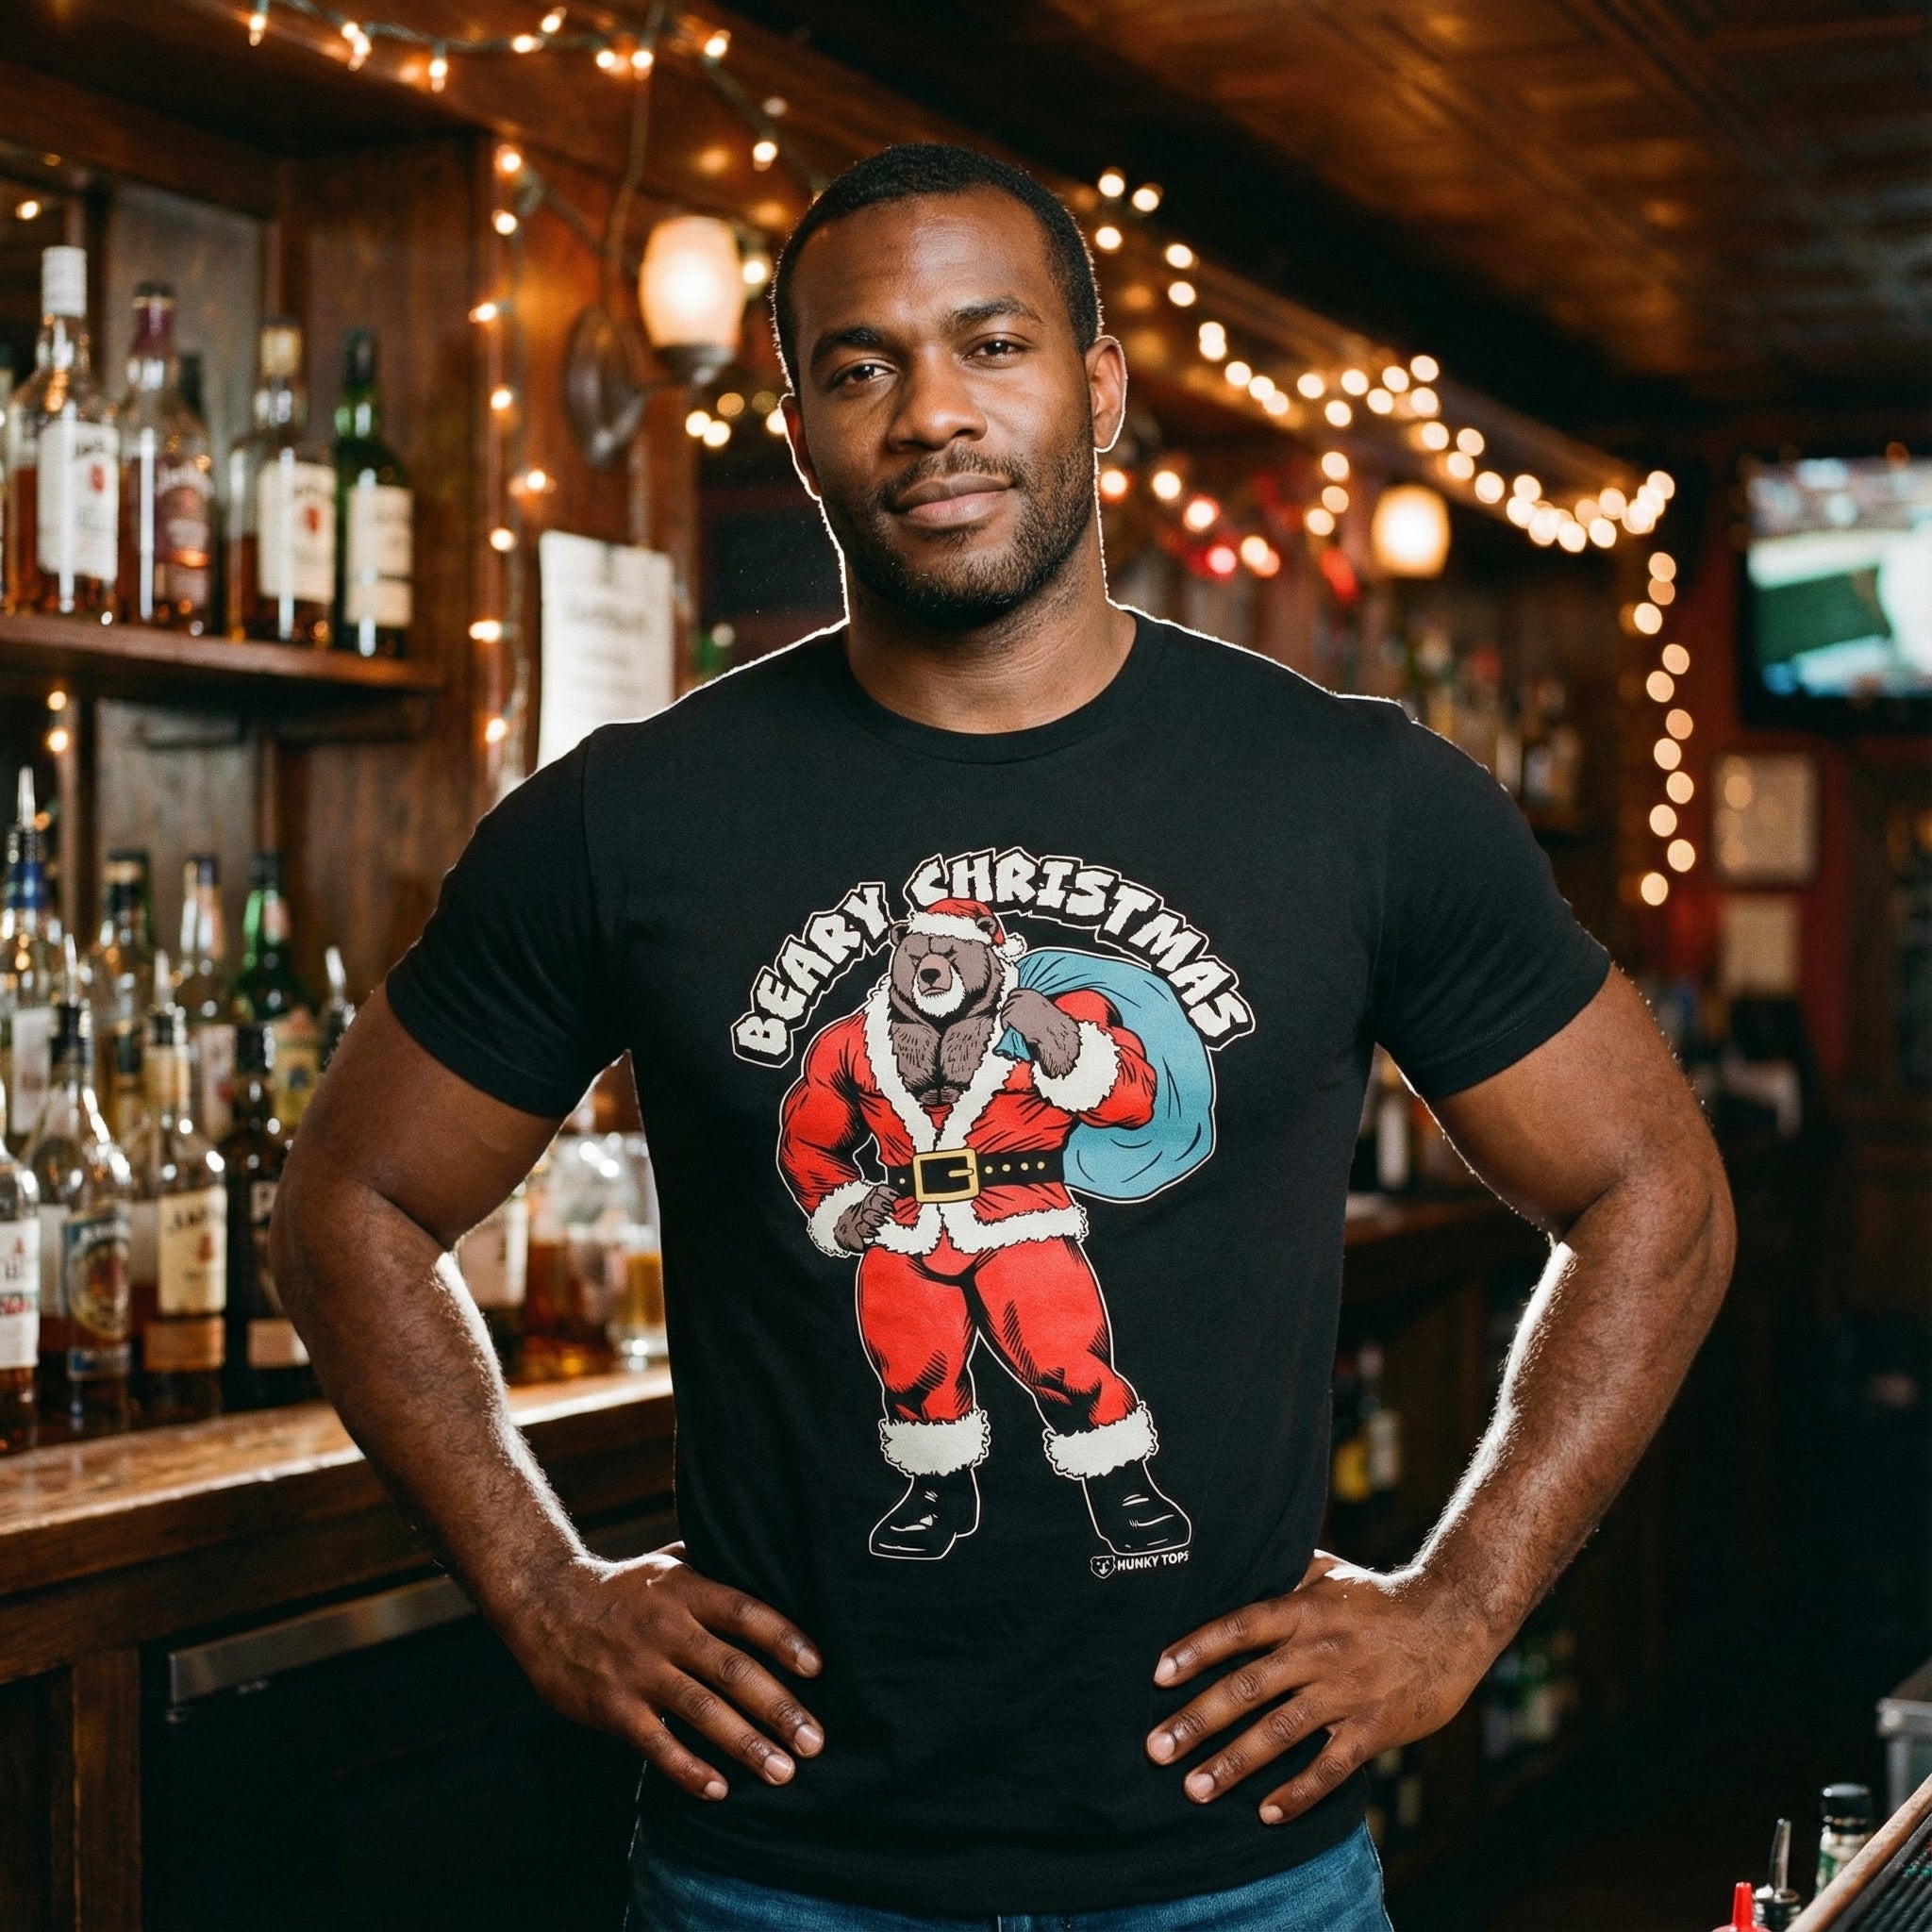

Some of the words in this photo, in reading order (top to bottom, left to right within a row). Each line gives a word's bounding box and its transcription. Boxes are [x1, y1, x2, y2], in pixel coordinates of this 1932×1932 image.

[735, 886, 890, 1057] BEARY
[907, 851, 1250, 1039] CHRISTMAS
[1117, 1556, 1159, 1571] HUNKY
[1160, 1551, 1190, 1566] TOPS
